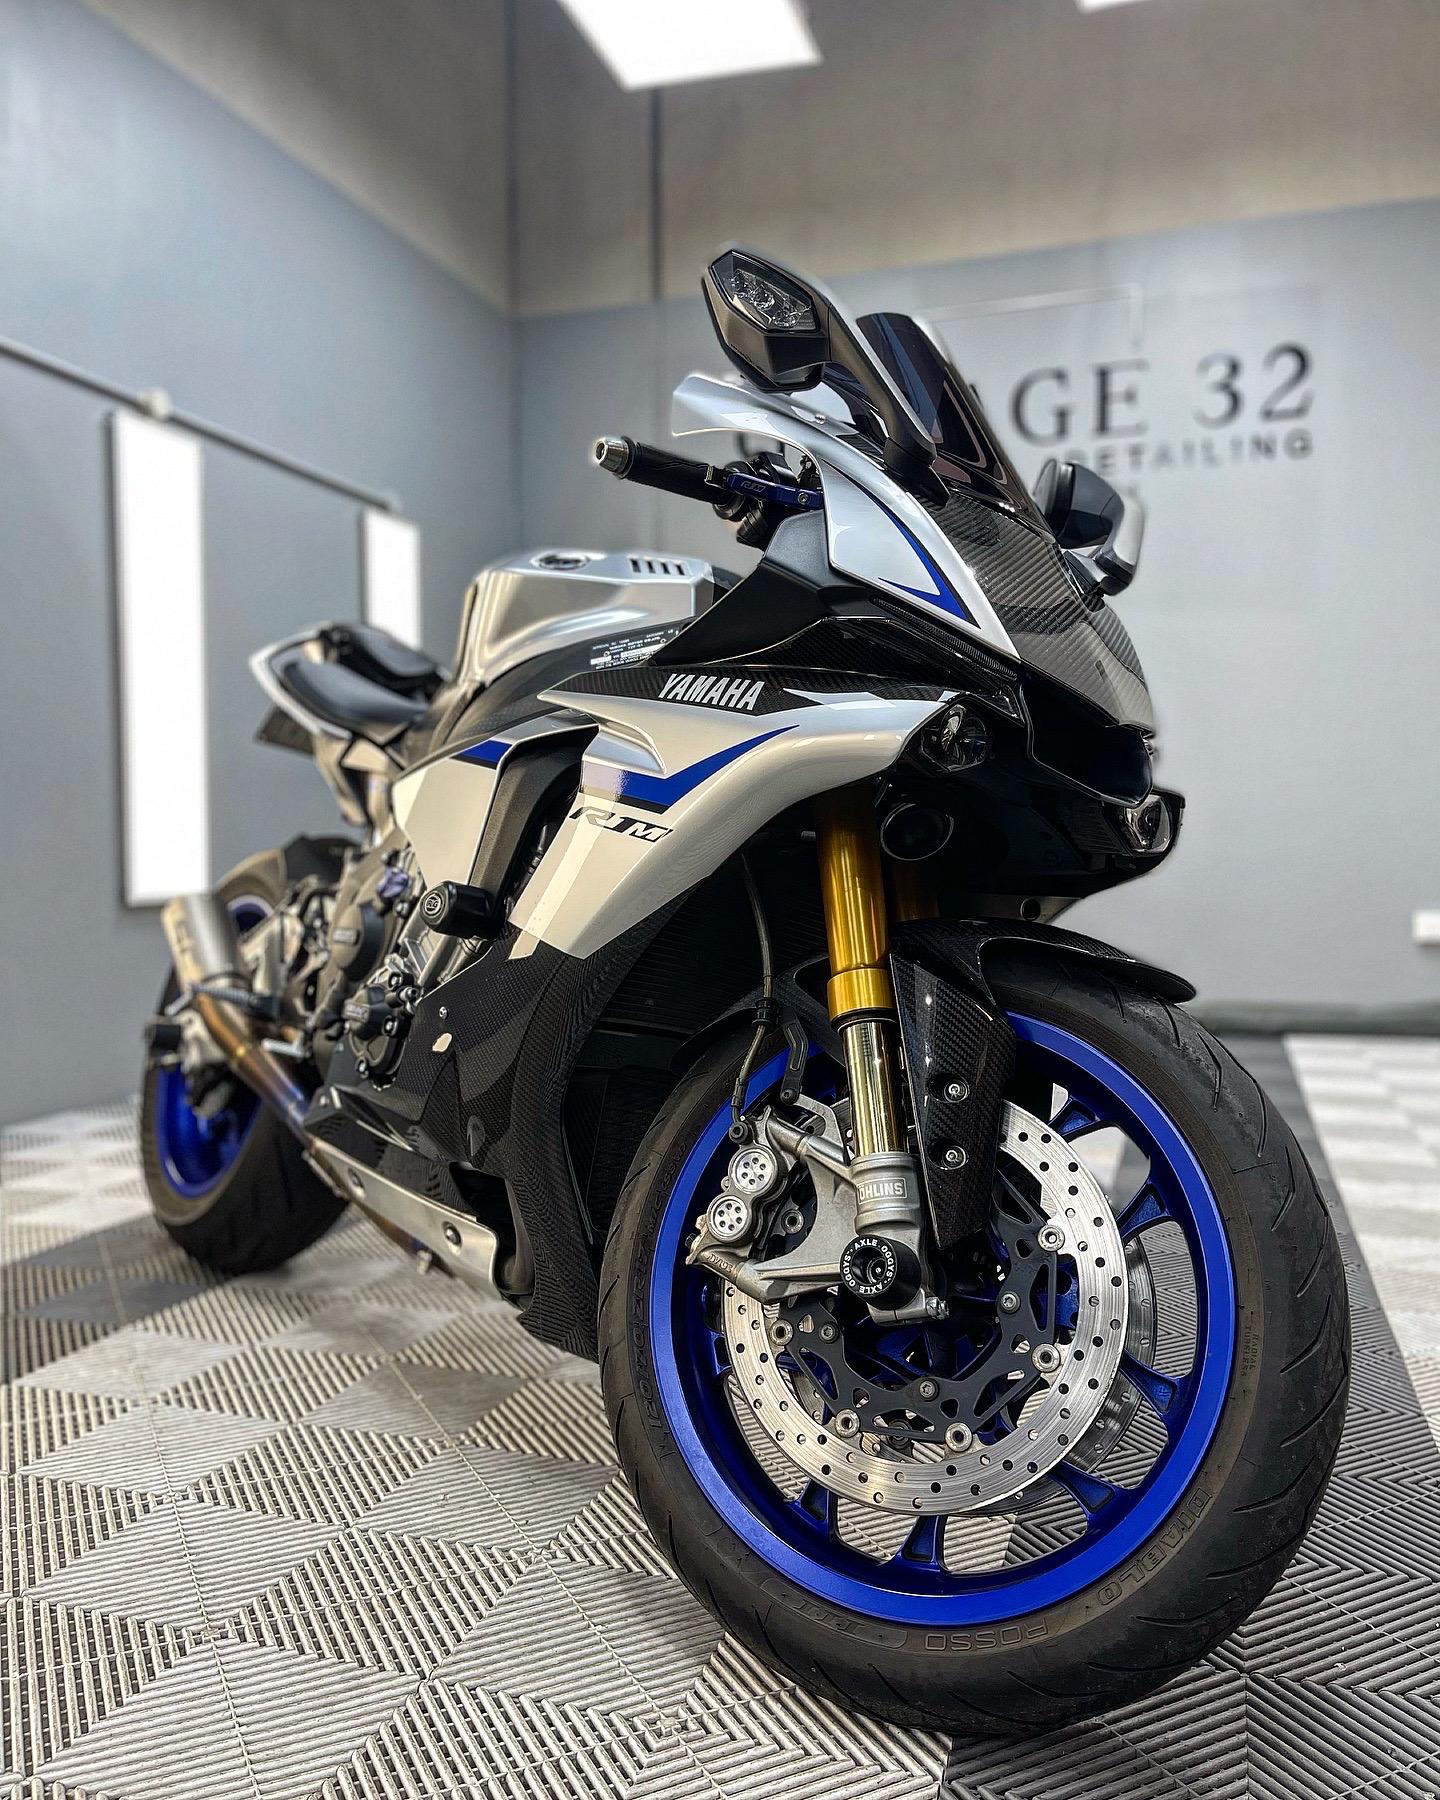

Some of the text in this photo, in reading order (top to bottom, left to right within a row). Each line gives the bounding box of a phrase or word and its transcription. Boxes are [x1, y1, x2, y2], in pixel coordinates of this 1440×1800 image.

[1008, 341, 1316, 447] GE 32
[658, 673, 765, 711] YAMAHA
[569, 806, 674, 842] R1M
[854, 1238, 878, 1250] AXLE
[859, 1281, 883, 1294] AXLE
[1097, 1487, 1213, 1606] DIABLO
[925, 1617, 1049, 1651] ROSSO
